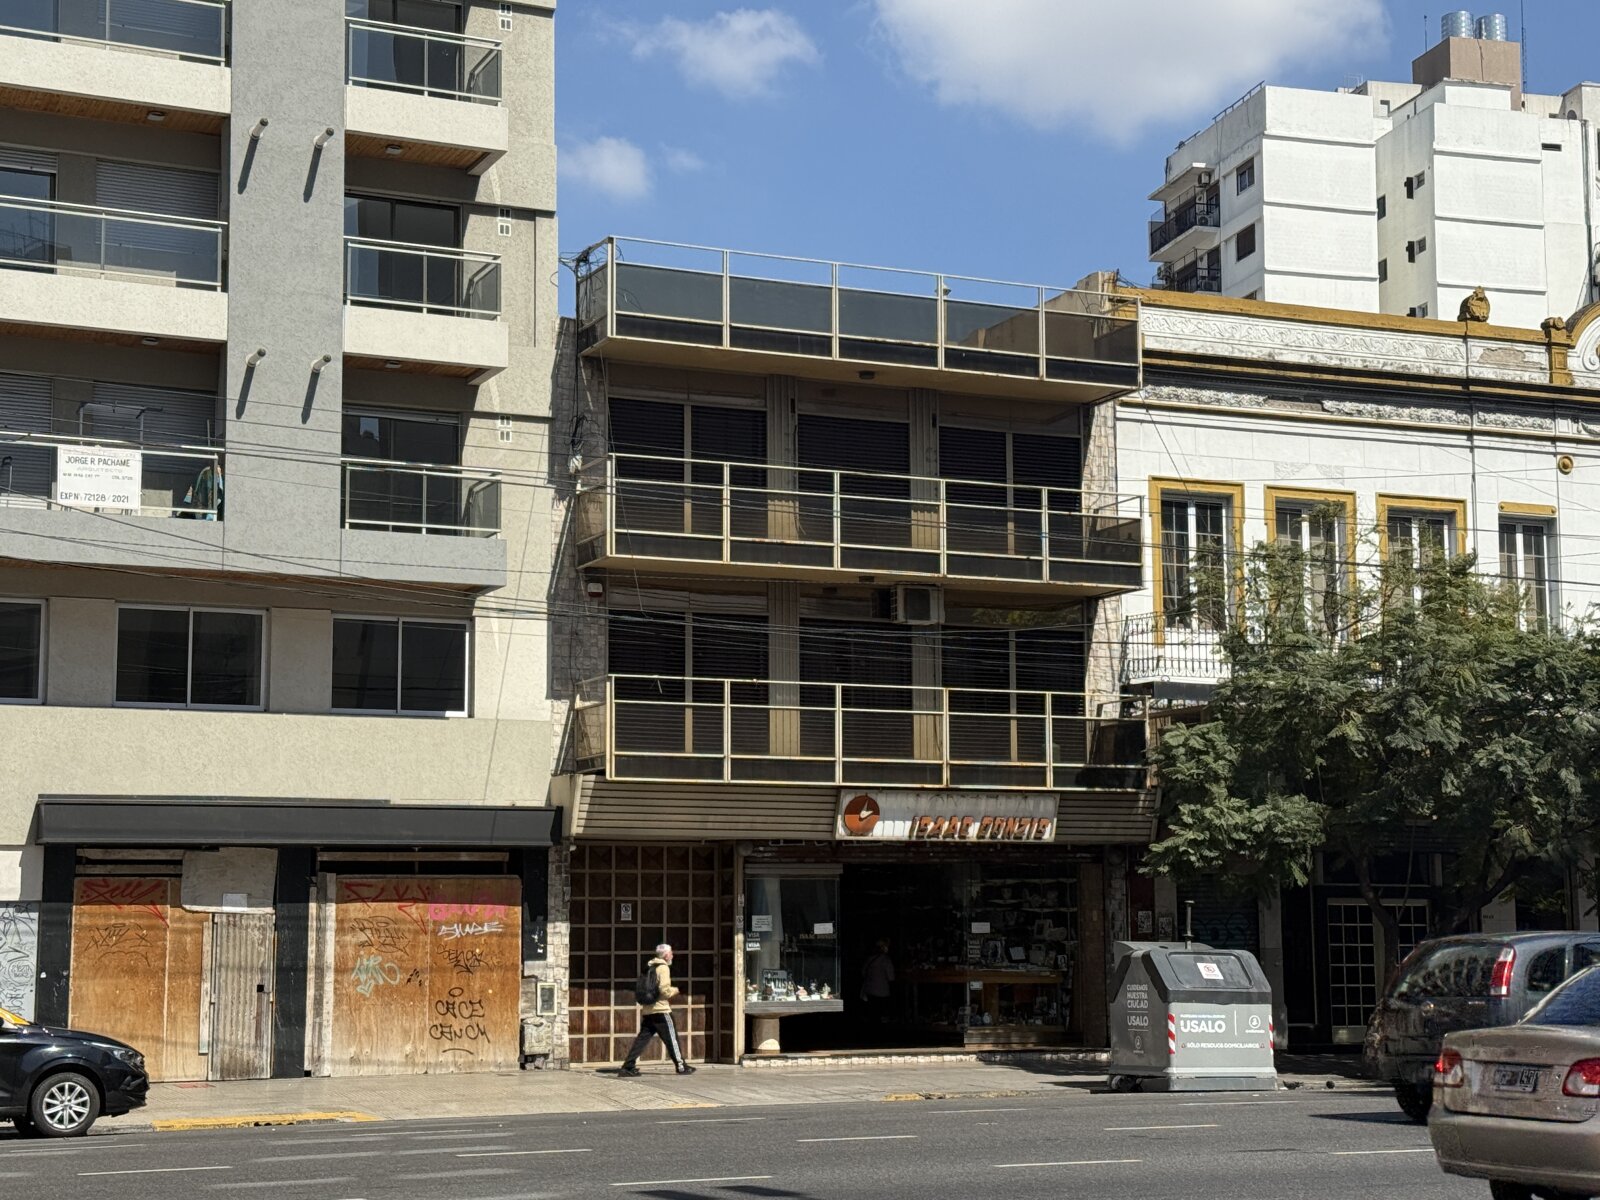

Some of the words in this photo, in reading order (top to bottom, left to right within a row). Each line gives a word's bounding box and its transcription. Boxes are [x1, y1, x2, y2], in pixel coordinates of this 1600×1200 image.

[65, 456, 88, 465] JORGE
[97, 458, 131, 467] PACHAME
[112, 494, 129, 503] 2021
[909, 816, 974, 840] ISAAC
[1127, 991, 1148, 999] NUESTRA
[1127, 1015, 1149, 1027] USALO
[1180, 1019, 1226, 1033] USALO
